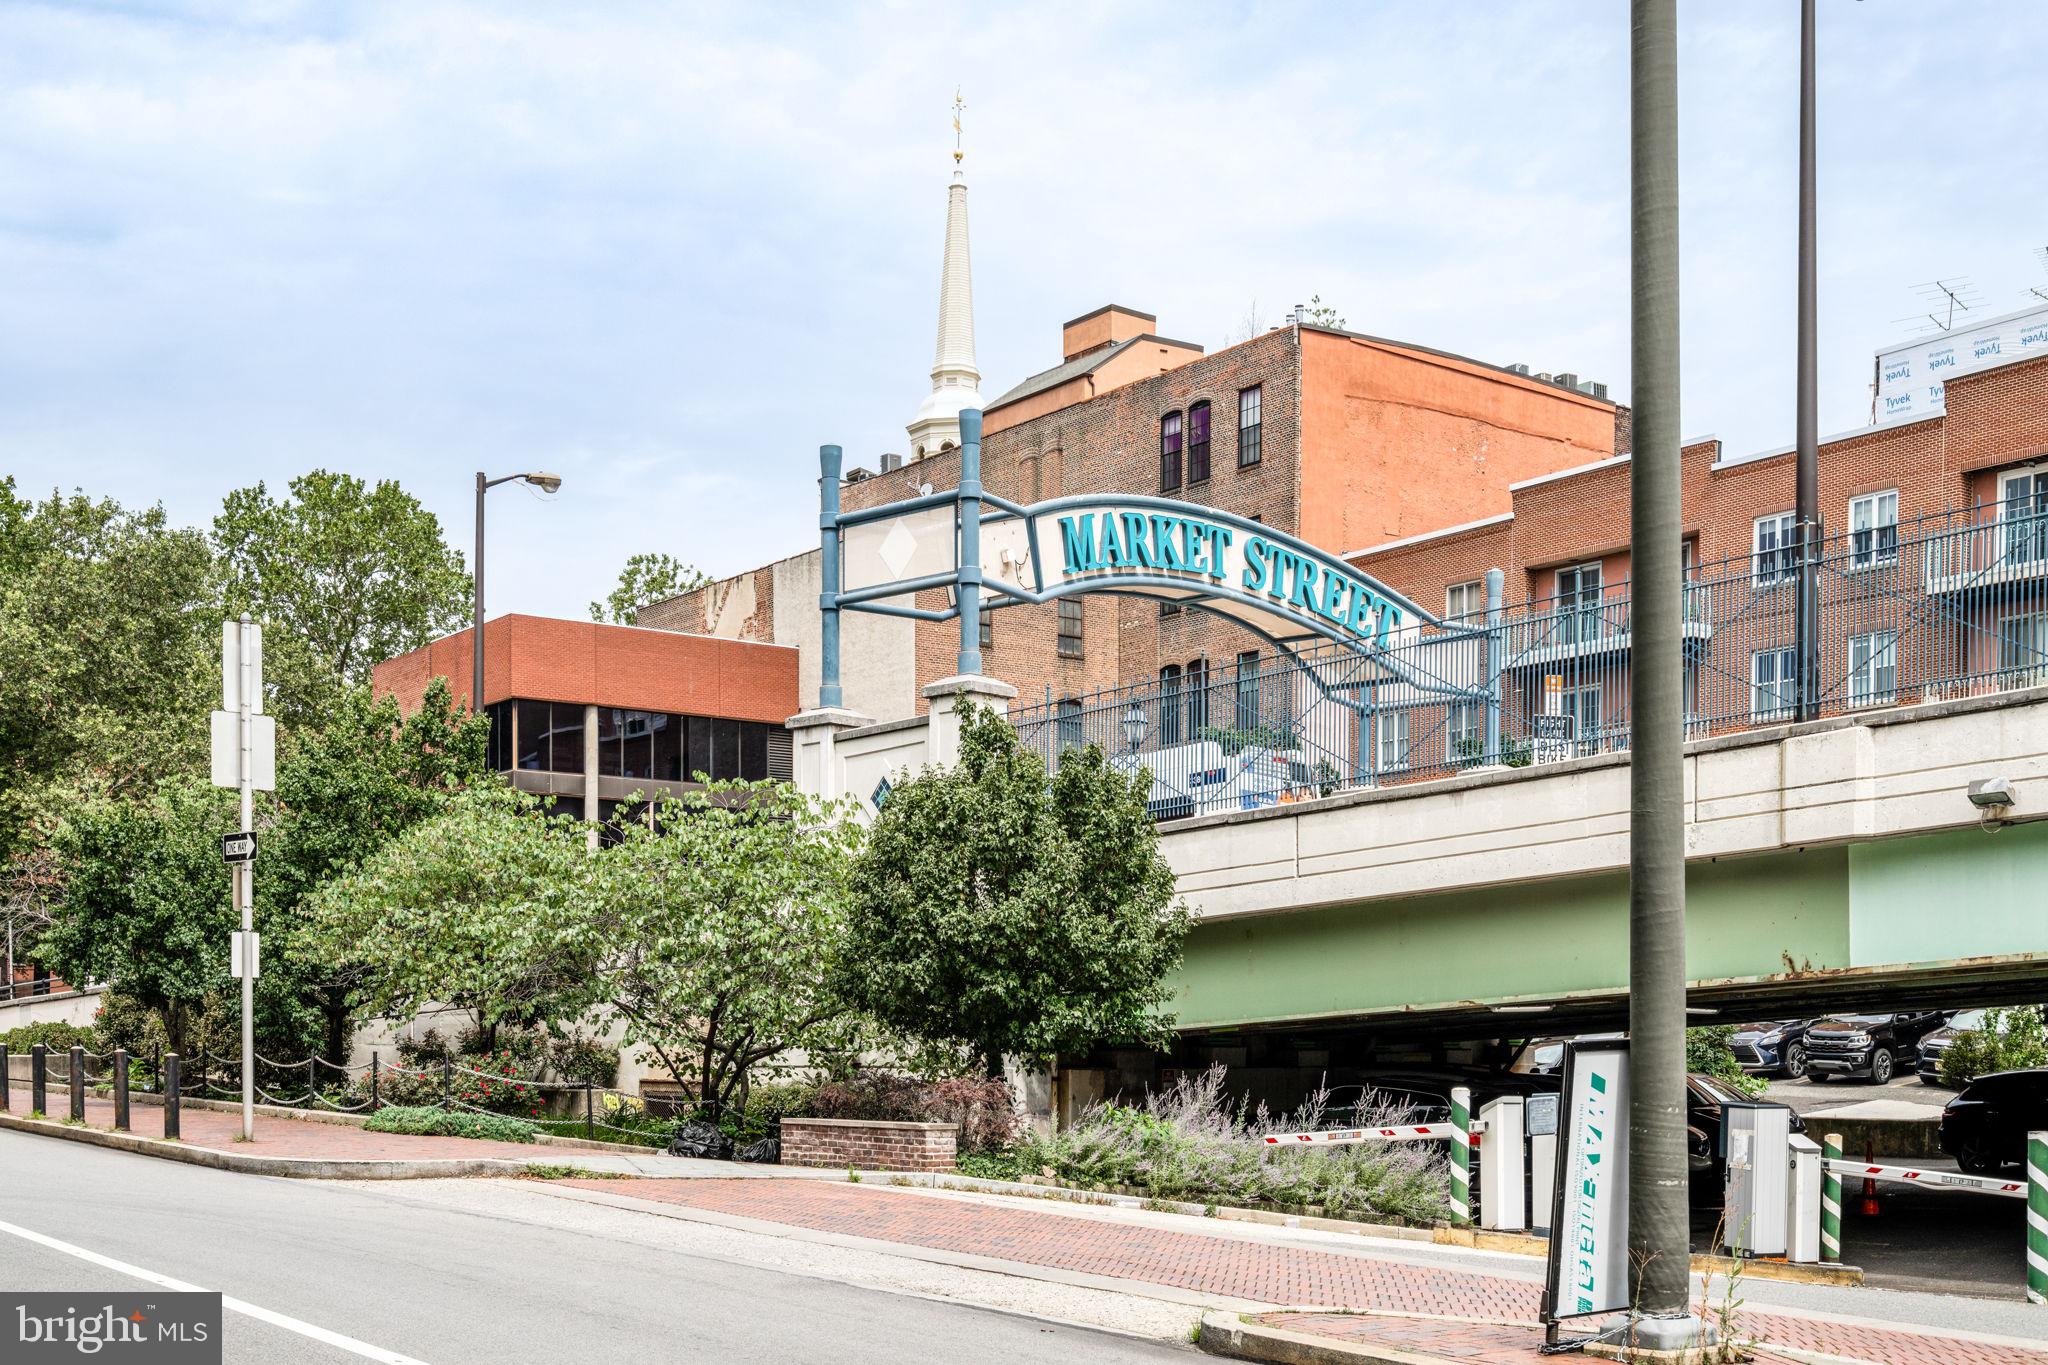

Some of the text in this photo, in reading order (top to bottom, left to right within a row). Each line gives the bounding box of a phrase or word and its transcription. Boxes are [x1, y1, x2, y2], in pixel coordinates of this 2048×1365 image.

[1974, 342, 2001, 359] Tyvek
[1929, 355, 1955, 371] Tyvek
[1885, 367, 1911, 383] Tyvek
[1885, 393, 1911, 408] Tyvek
[1058, 511, 1403, 651] MARKET STREET
[1538, 754, 1567, 765] BIKE
[227, 841, 248, 853] ONE WAY
